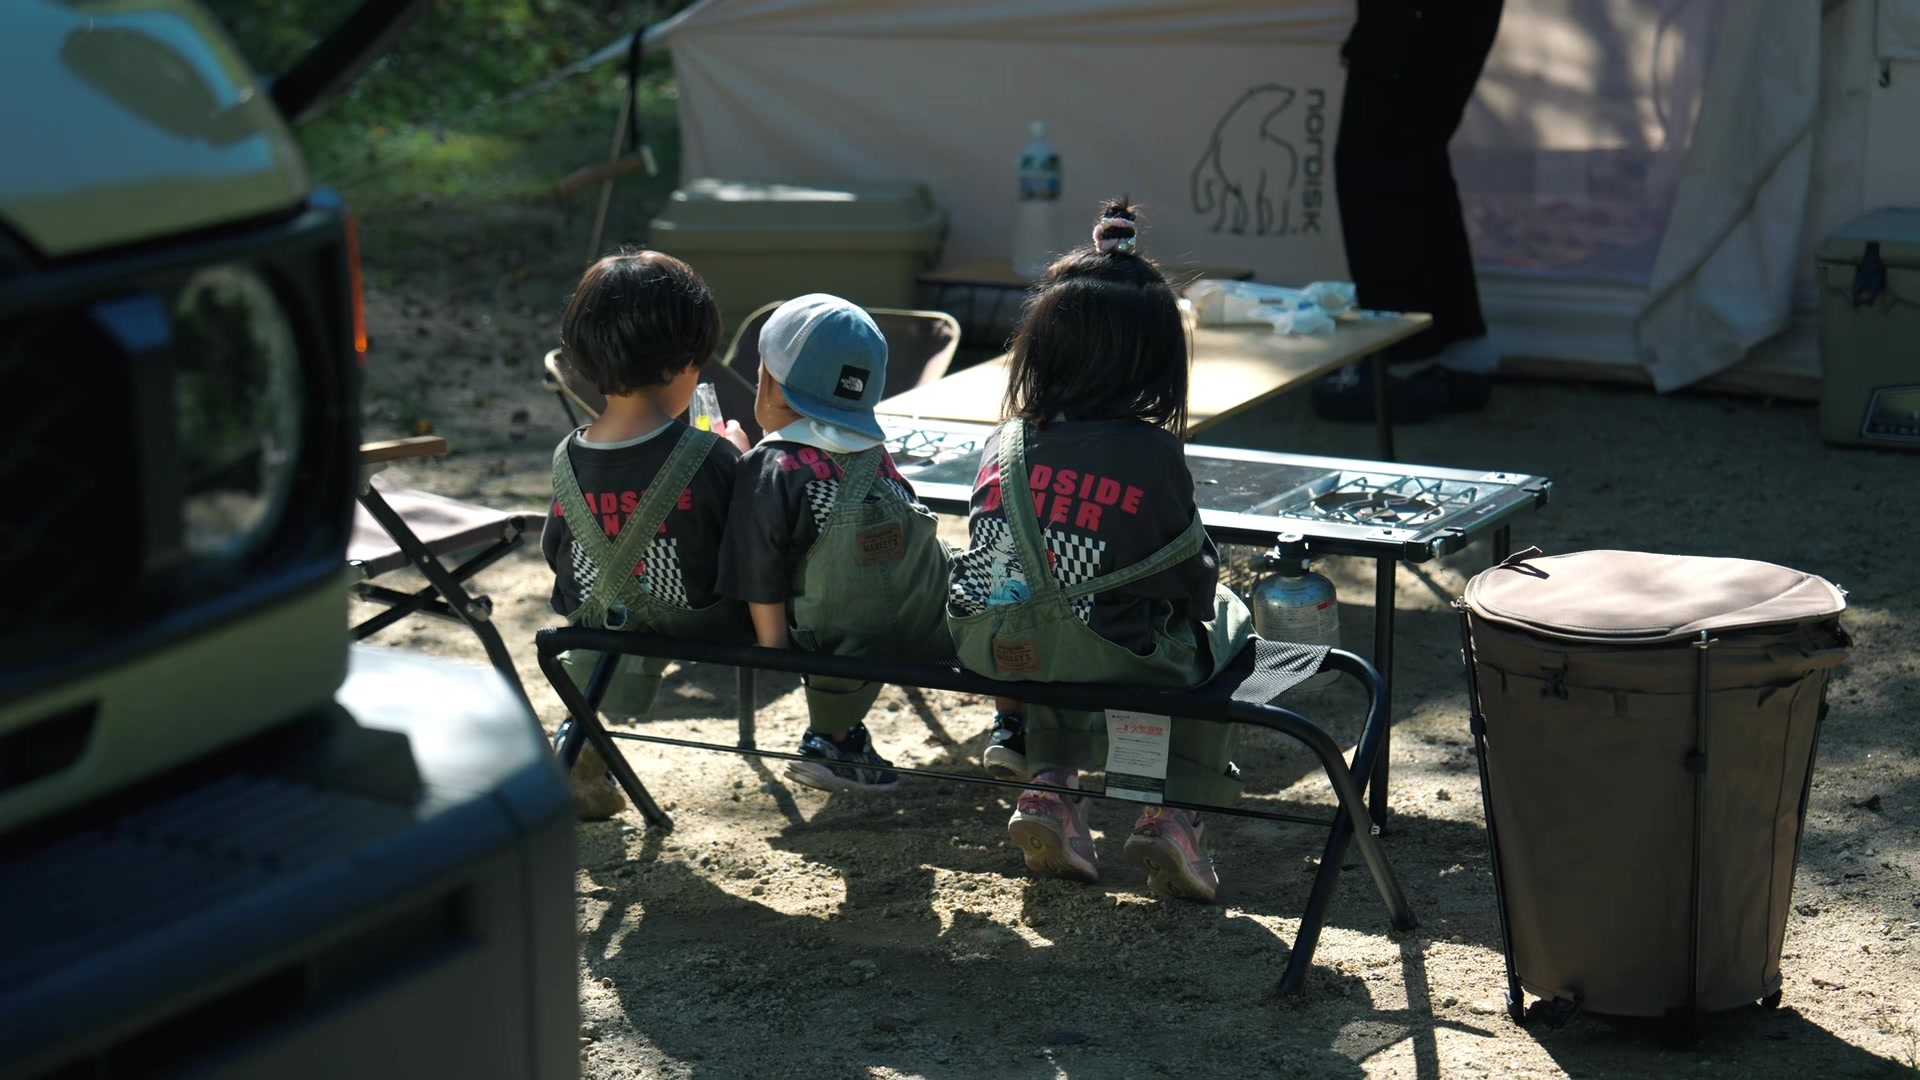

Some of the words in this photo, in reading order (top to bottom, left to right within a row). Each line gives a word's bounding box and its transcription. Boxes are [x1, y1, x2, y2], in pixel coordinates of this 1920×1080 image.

[1302, 88, 1325, 233] nordisk
[553, 488, 693, 517] ADSE
[978, 464, 1145, 515] DSIDE
[983, 485, 1103, 531] DNER
